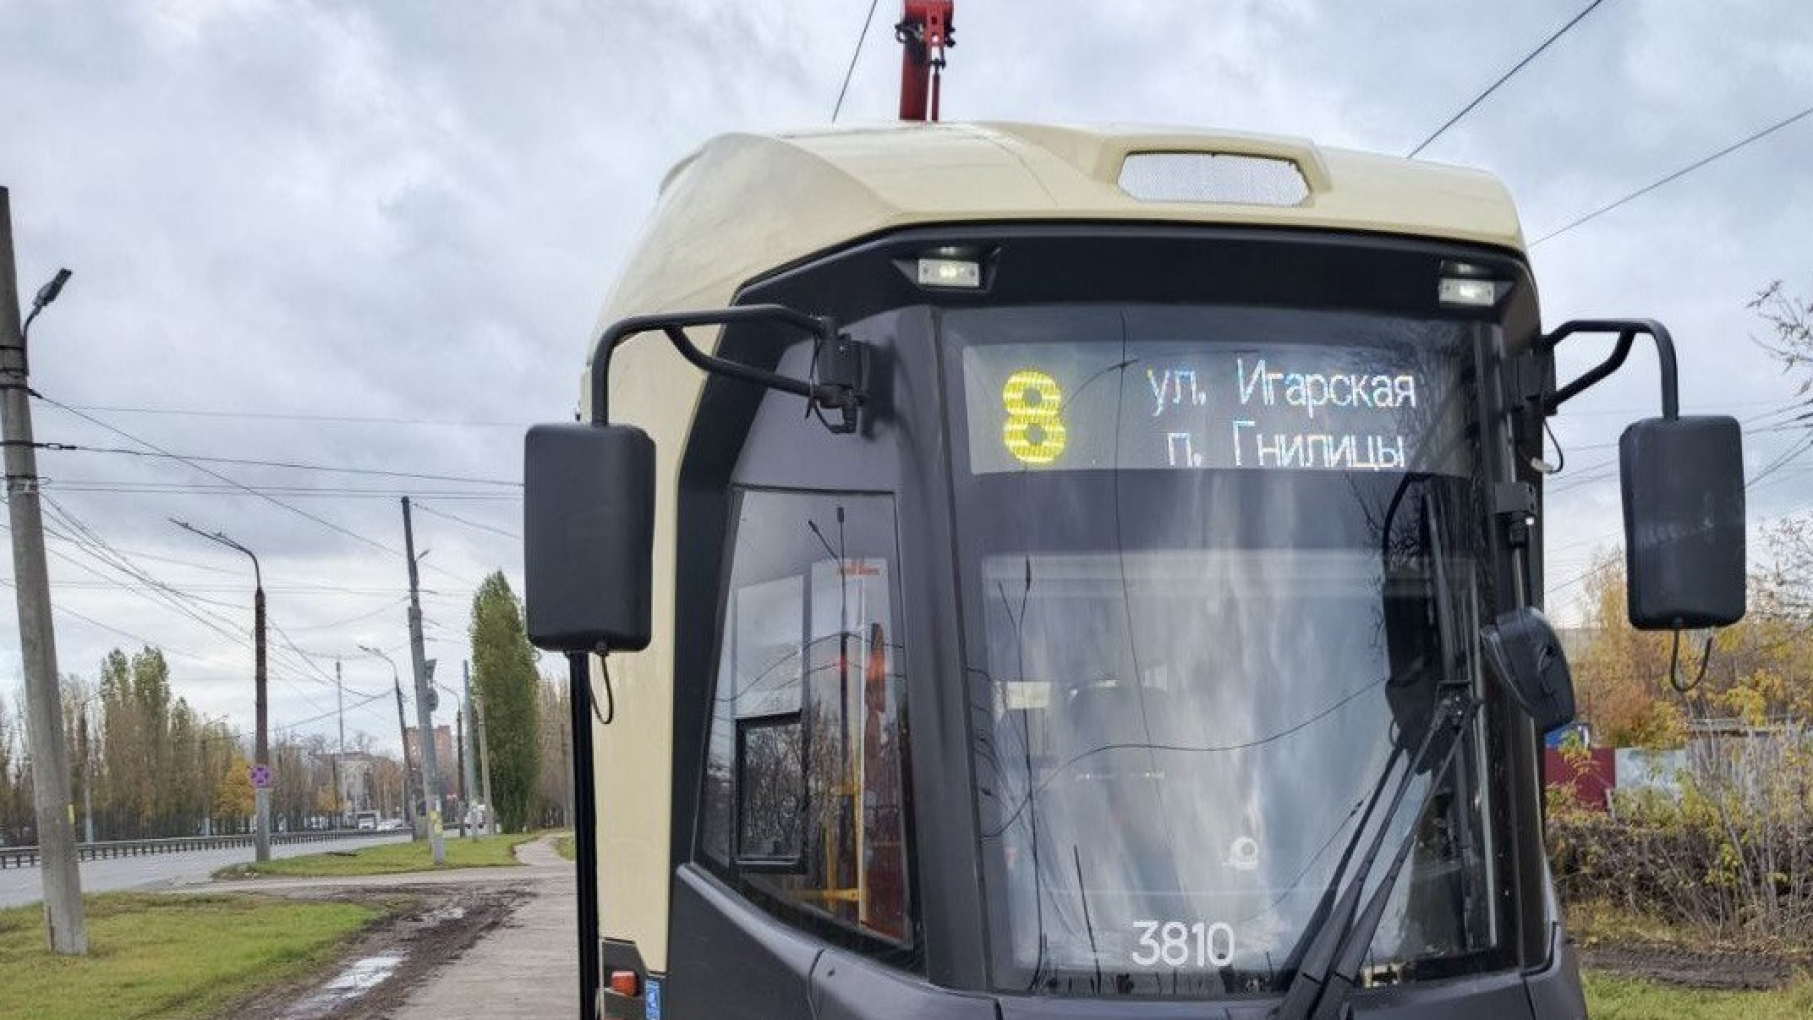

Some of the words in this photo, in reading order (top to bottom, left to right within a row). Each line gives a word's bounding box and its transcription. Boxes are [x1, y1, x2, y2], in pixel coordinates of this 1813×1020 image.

[1147, 368, 1206, 416] ул.
[1237, 358, 1417, 418] Игарская
[1003, 370, 1066, 464] 8
[1167, 432, 1202, 467] п.
[1232, 420, 1405, 471] Гнилицы
[1131, 921, 1236, 967] 3810
